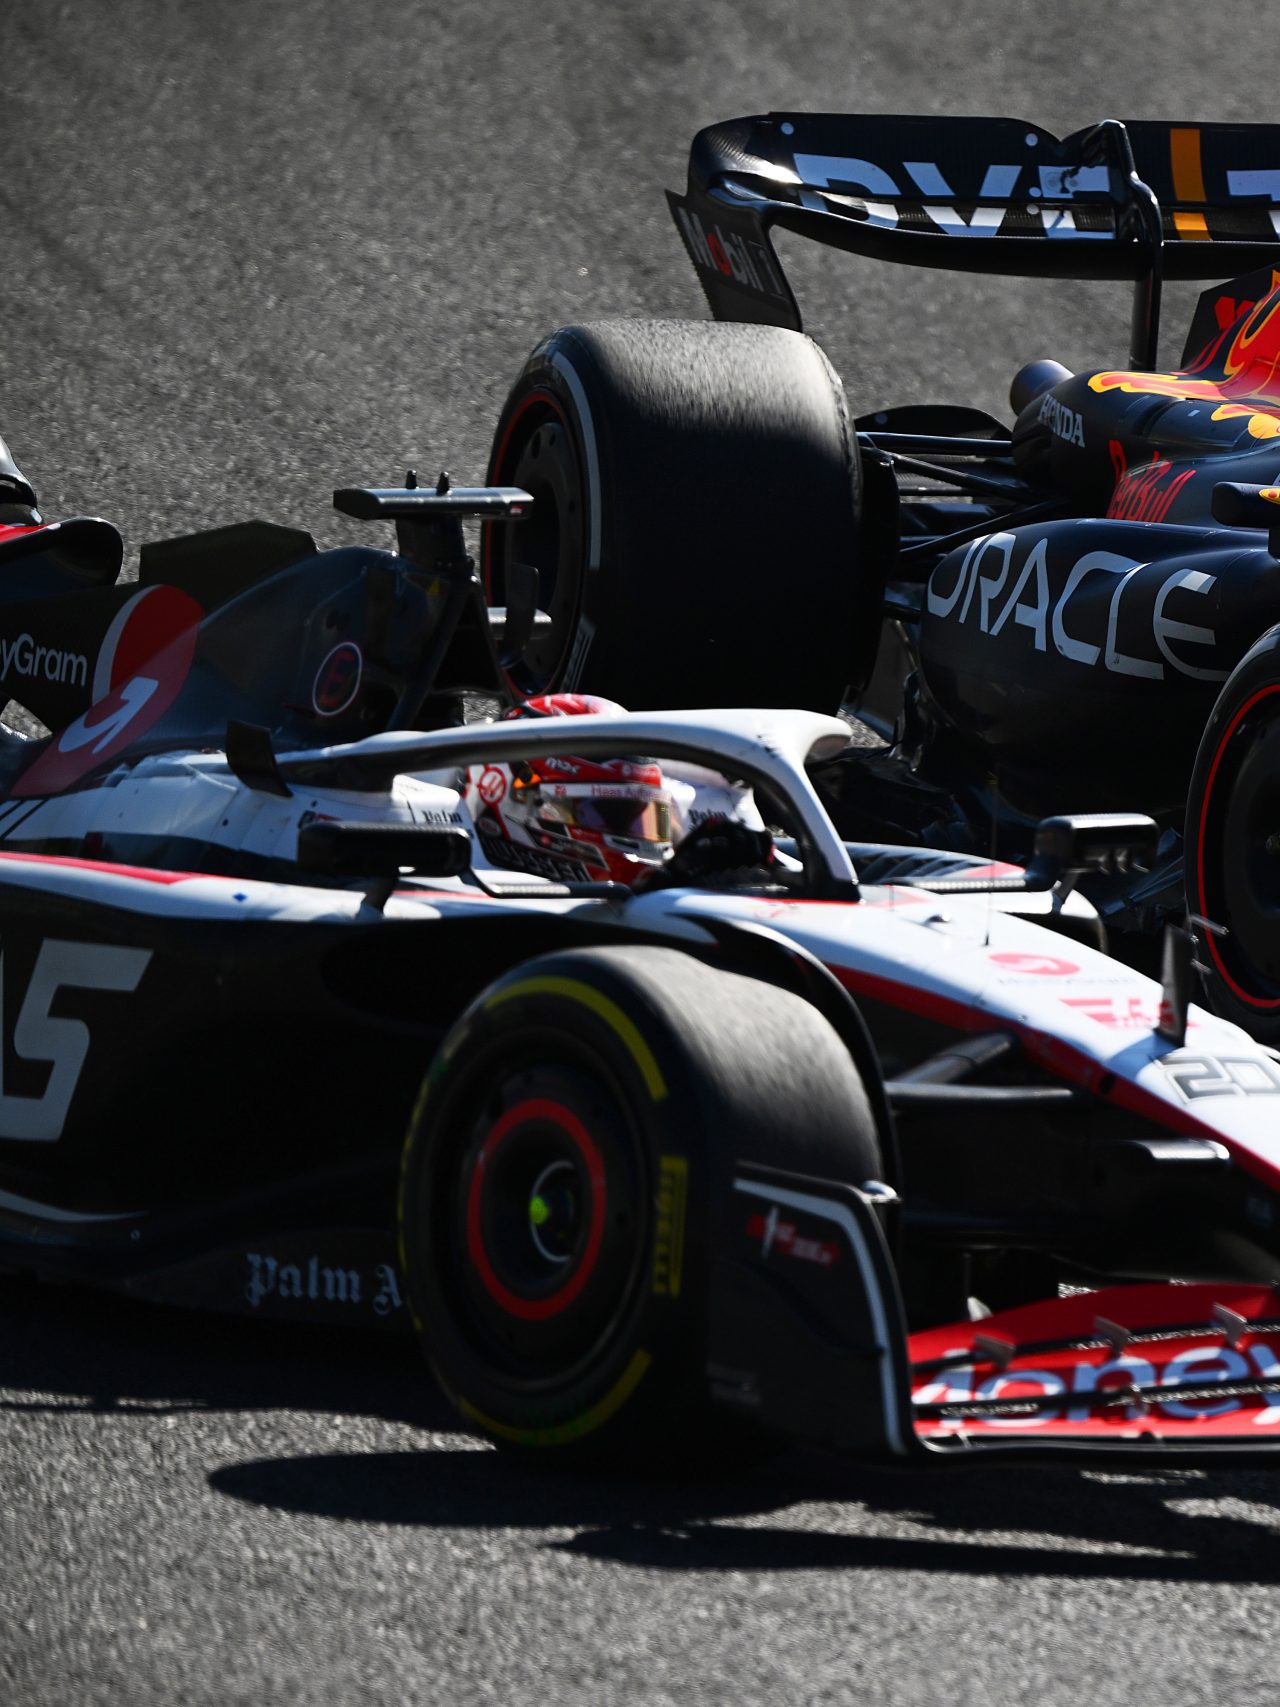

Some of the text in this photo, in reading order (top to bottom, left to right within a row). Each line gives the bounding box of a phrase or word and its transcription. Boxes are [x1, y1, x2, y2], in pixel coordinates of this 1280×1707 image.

[1039, 394, 1086, 448] HONDA
[927, 532, 1233, 682] ORACLE
[245, 1252, 363, 1308] Palm
